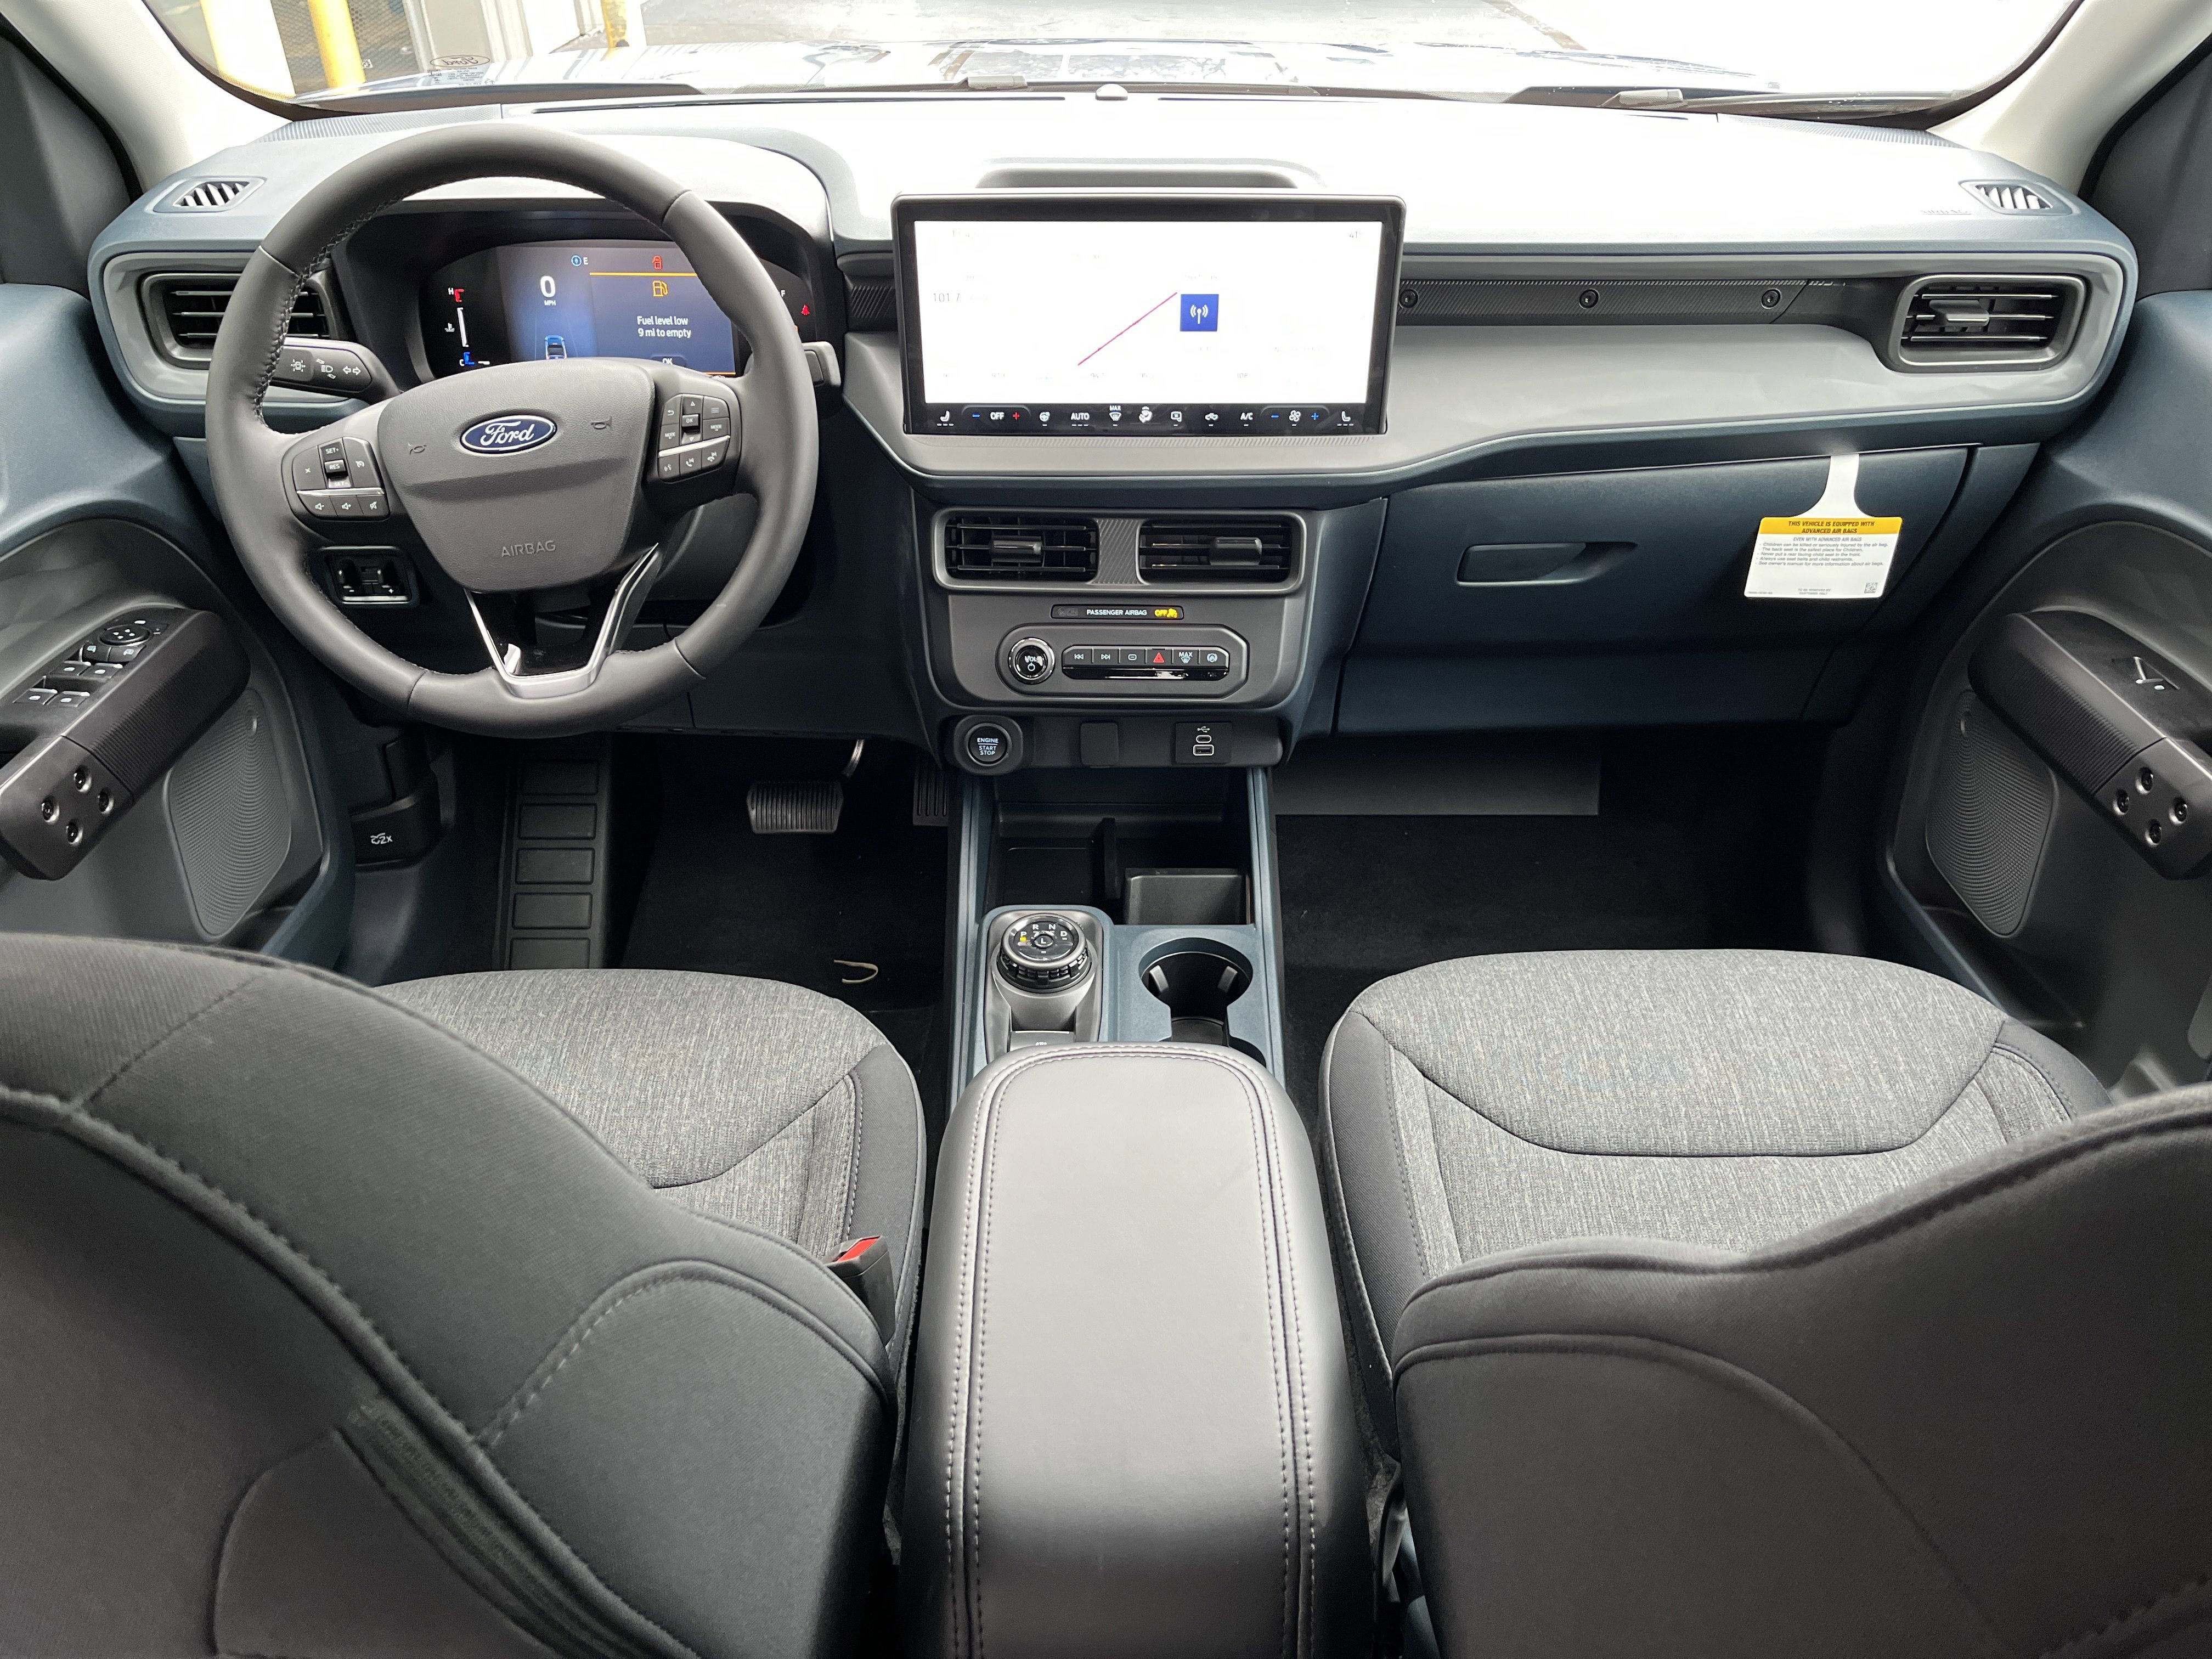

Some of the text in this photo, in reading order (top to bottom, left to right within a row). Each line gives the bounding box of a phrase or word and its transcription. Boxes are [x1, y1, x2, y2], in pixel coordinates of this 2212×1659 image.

[540, 275, 556, 297] 0
[637, 315, 689, 325] Fuel level low
[637, 328, 691, 338] 9 mi to empty
[480, 421, 535, 446] Ford
[501, 540, 556, 557] AIRBAG
